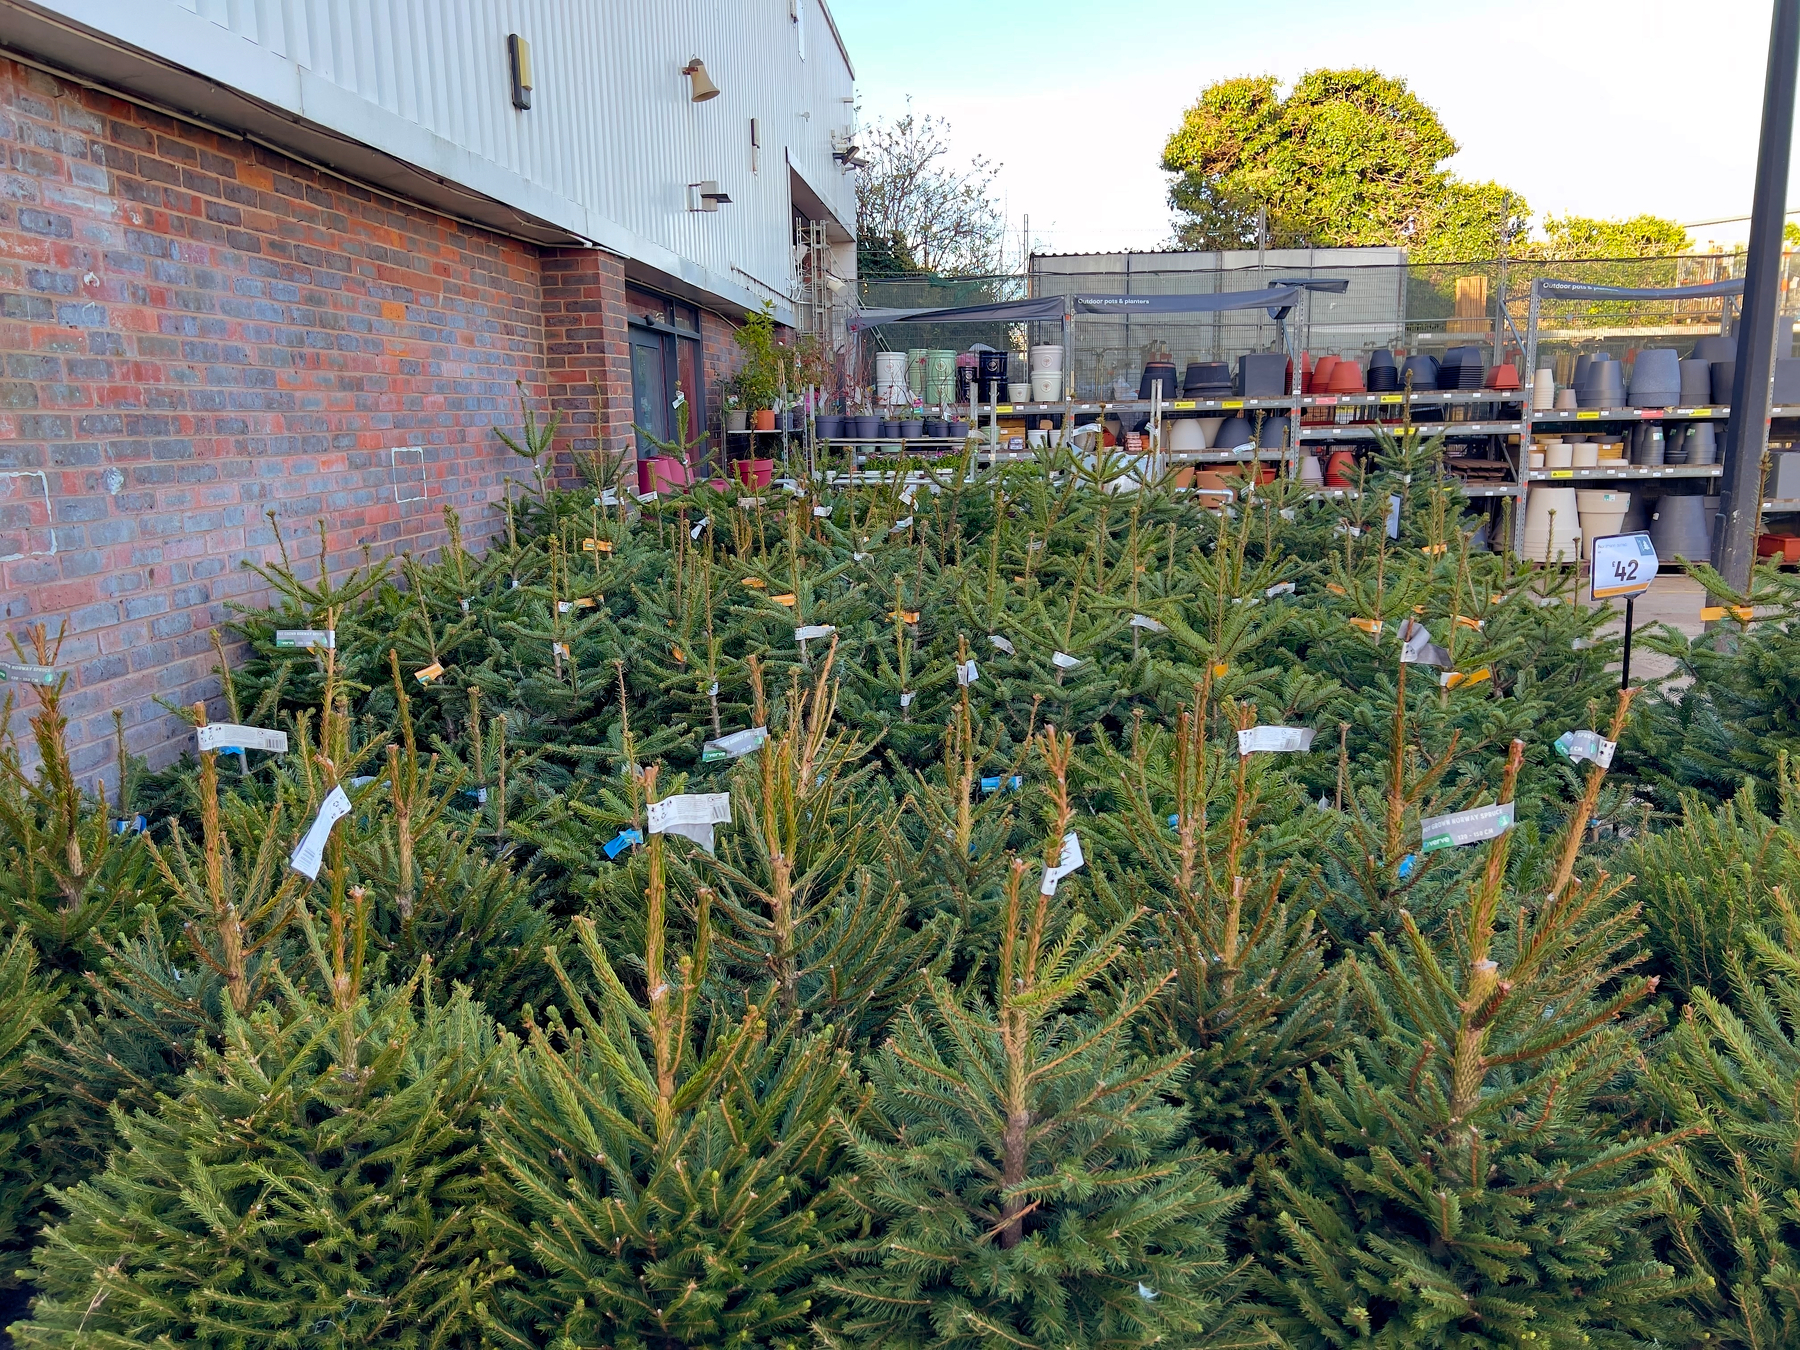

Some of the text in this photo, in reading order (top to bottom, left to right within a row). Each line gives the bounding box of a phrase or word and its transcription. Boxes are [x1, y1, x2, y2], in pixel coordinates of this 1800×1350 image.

[1431, 819, 1451, 830] GROWN
[1451, 814, 1479, 824] NORWAY
[1480, 808, 1503, 819] SPRUCE
[1473, 830, 1484, 838] 150
[1484, 827, 1494, 835] CM
[1428, 836, 1450, 846] verve
